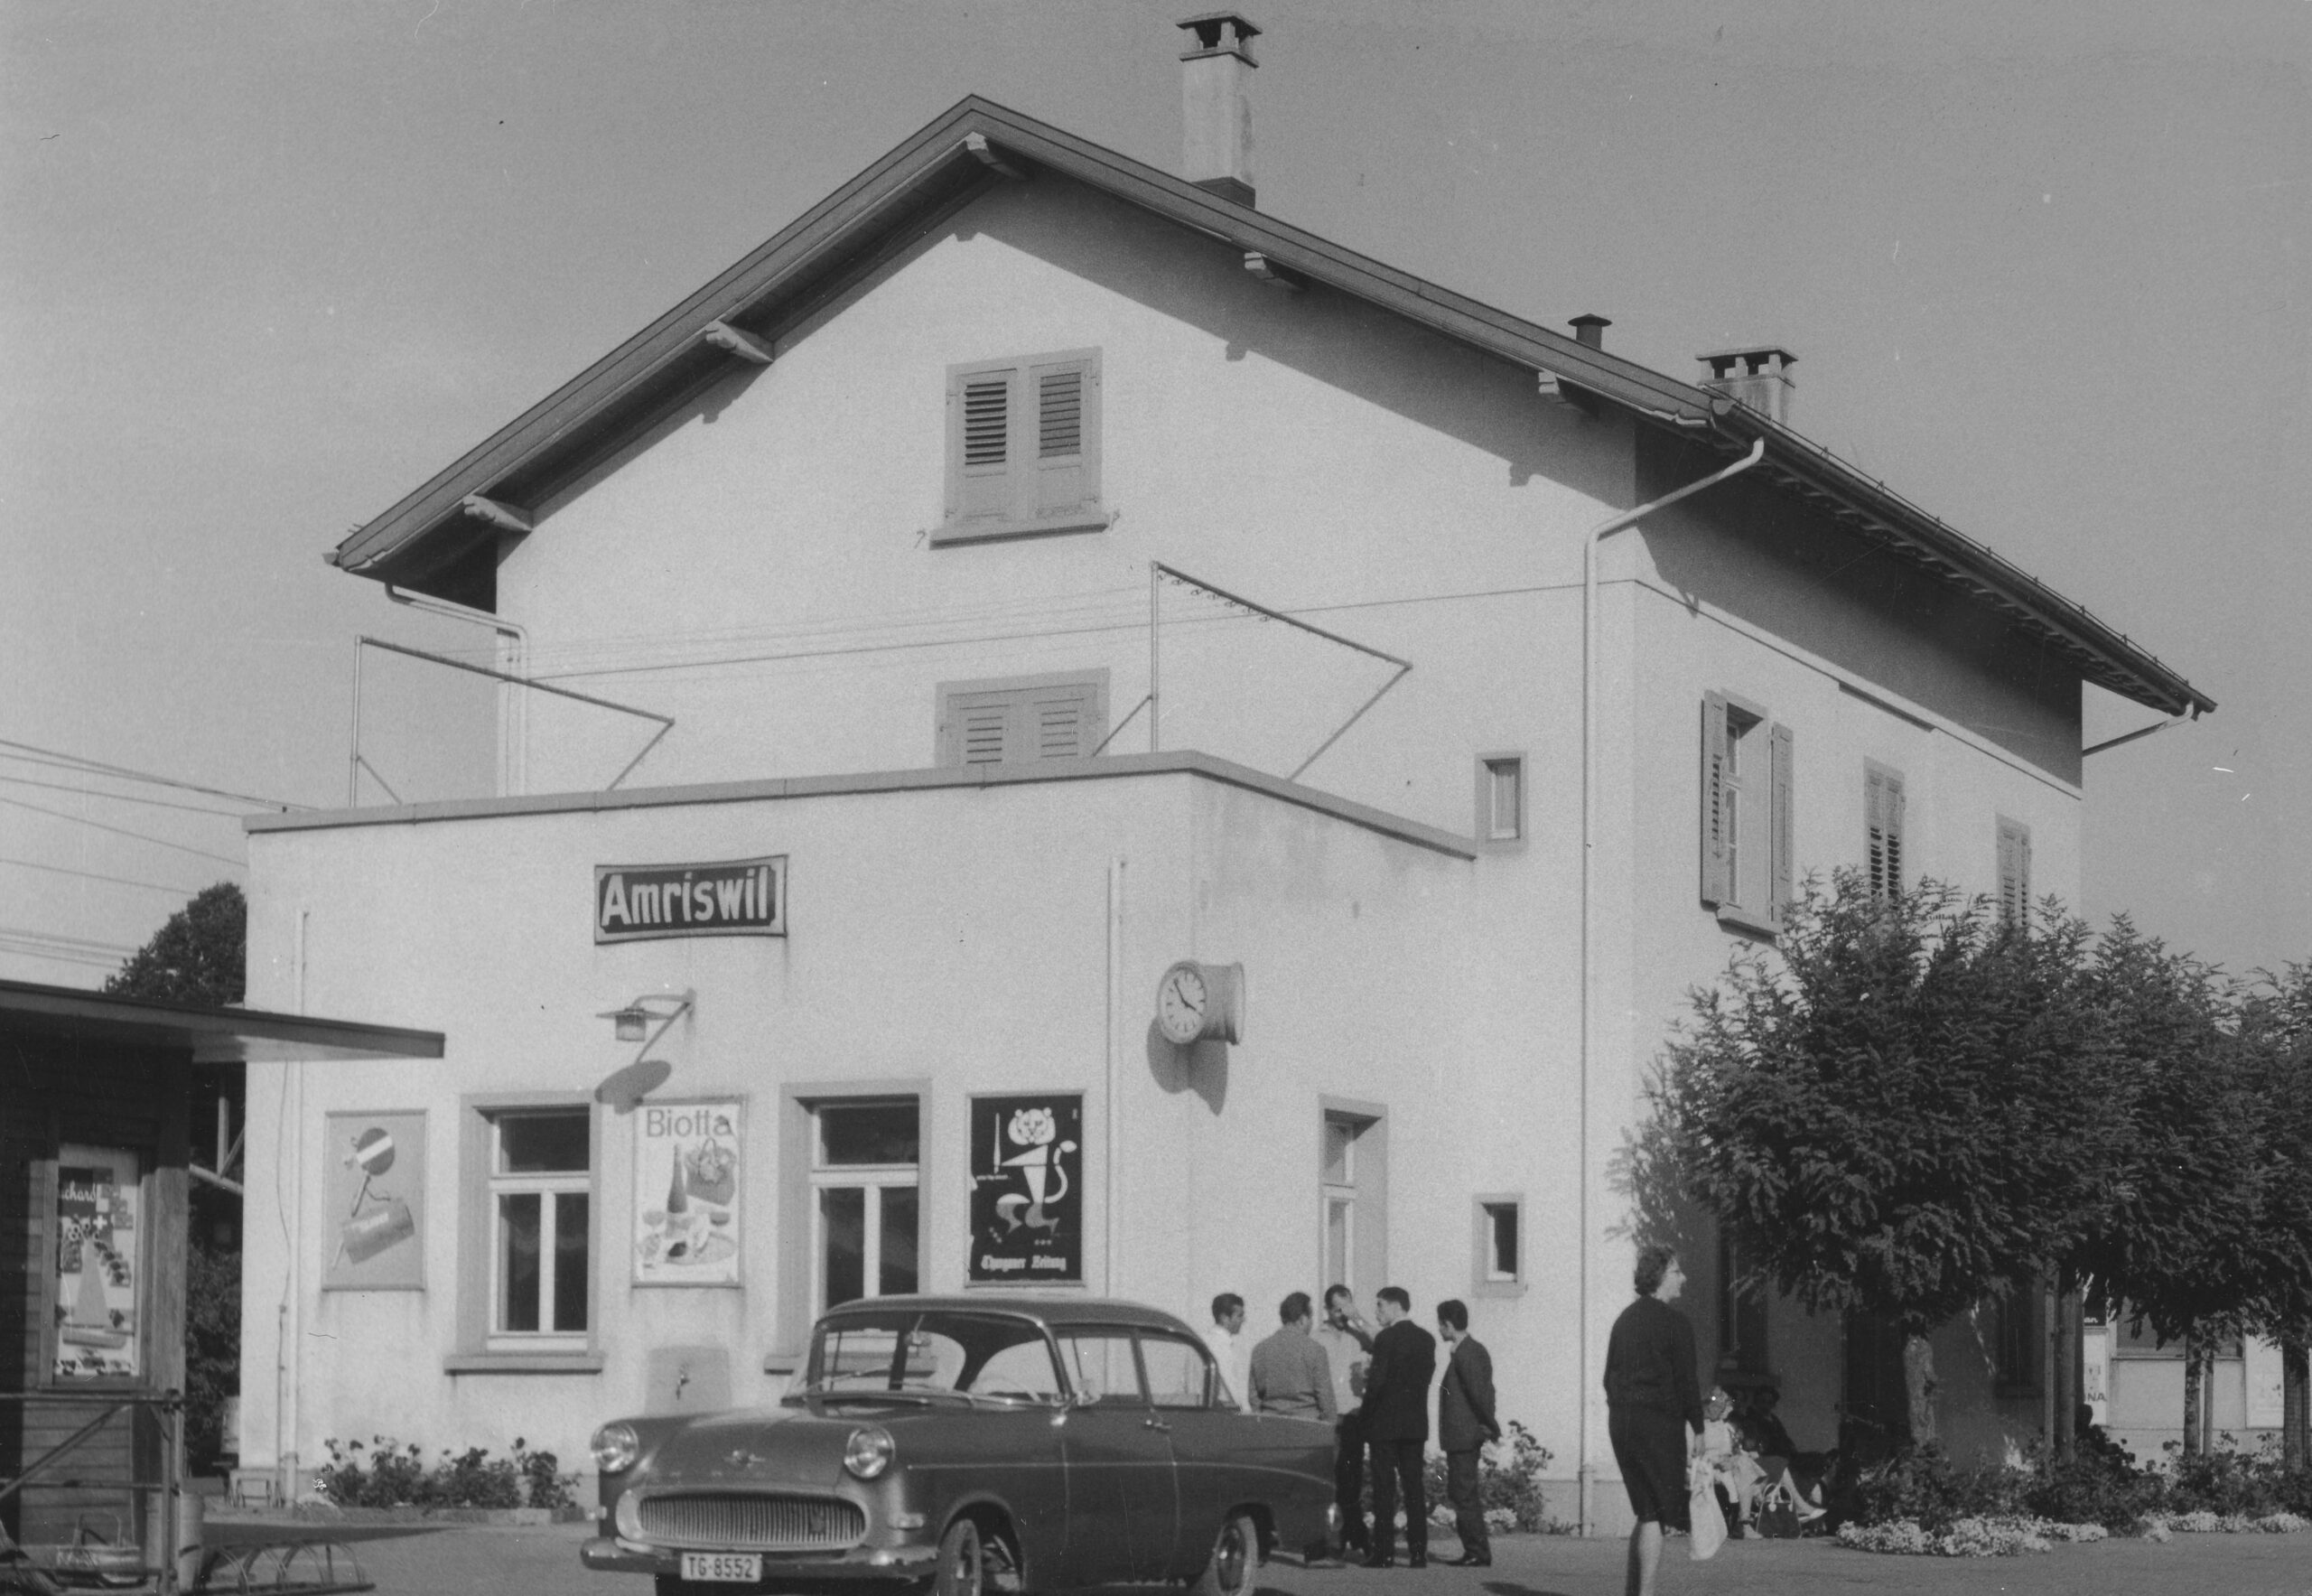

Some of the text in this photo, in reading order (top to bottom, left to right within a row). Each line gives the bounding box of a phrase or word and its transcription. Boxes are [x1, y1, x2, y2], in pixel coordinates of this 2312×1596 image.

[601, 867, 769, 927] Amriswil
[647, 1109, 732, 1137] Biotta
[61, 1180, 97, 1203] chard
